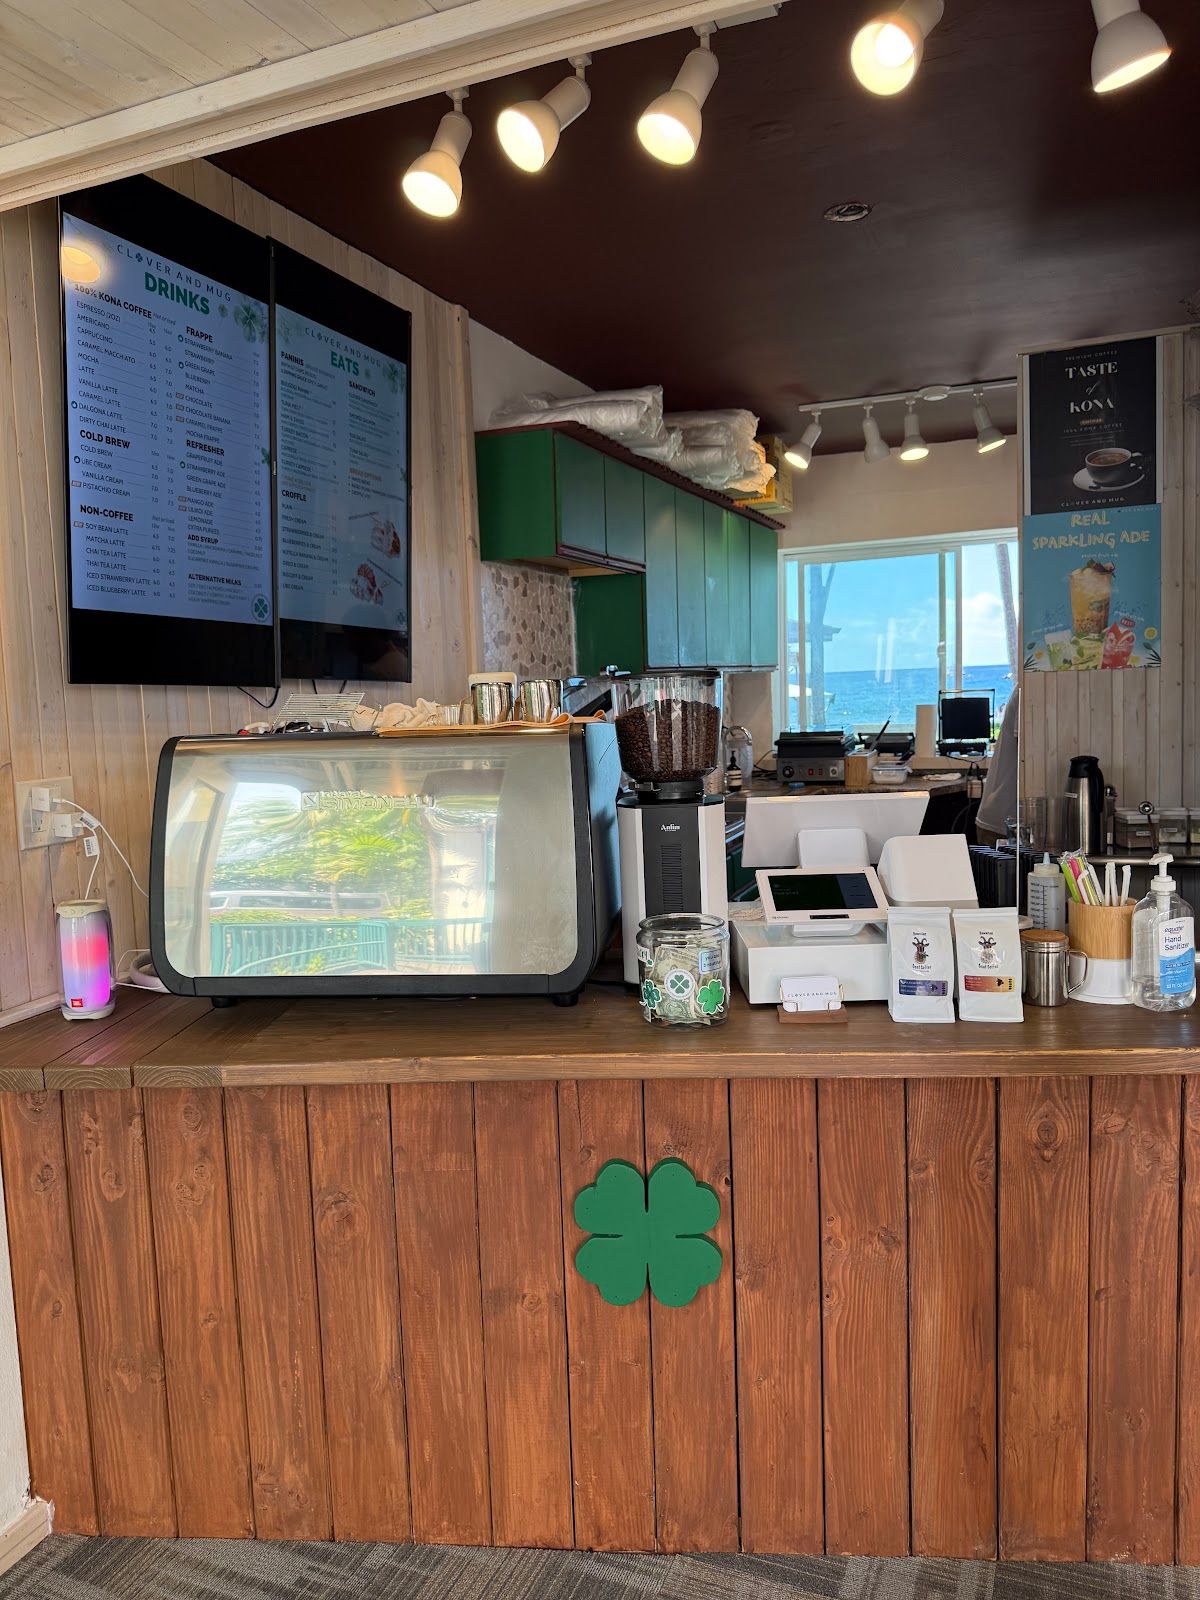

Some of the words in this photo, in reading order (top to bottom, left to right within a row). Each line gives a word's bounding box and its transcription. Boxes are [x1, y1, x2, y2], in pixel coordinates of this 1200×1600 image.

[145, 272, 209, 315] DRINKS
[177, 272, 201, 288] AND
[207, 284, 231, 302] MUG
[75, 284, 97, 298] 100%
[99, 292, 121, 307] KONA
[123, 302, 151, 319] COFFEE
[77, 301, 105, 317] ESPRESSO
[77, 314, 109, 329] AMERICANO
[78, 327, 113, 343] CAPPUCCINO
[186, 326, 213, 343] FRAPPE
[78, 340, 103, 353] CARAMEL
[105, 349, 135, 363] MACCHIATO
[184, 337, 214, 352] STRAWBERRY
[215, 348, 233, 360] BANANA
[344, 346, 361, 358] AND
[78, 353, 99, 364] MOCHA
[281, 351, 304, 366] PANINIS
[330, 351, 359, 376] EATS
[79, 365, 95, 374] LATTE
[185, 361, 200, 371] GREEN
[201, 366, 216, 376] GRAPE
[1065, 361, 1118, 379] TASTE
[79, 378, 102, 390] VANILLA
[103, 385, 118, 394] LATTE
[185, 384, 204, 394] MATCHA
[349, 381, 376, 397] SANDWICH
[79, 390, 104, 403] CARAMEL
[105, 398, 121, 407] LATTE
[185, 395, 213, 408] CHOCOLATE
[1070, 398, 1114, 413] KONA
[79, 403, 106, 416] DALGONA
[107, 410, 123, 420] LATTE
[185, 407, 212, 419] CHOCOLATE
[213, 415, 231, 425] BANANA
[79, 415, 95, 425] DIRTY
[97, 421, 110, 429] CHAI
[110, 424, 127, 433] LATTE
[185, 418, 206, 428] CARAMEL
[80, 429, 103, 442] COLD
[105, 436, 130, 449] BREW
[186, 430, 203, 438] MOCHA
[80, 444, 96, 454] COLD
[97, 448, 113, 457] BREW
[187, 440, 224, 456] REFRESHER
[93, 461, 112, 470] CREAM
[187, 464, 216, 475] STRAWBERRY
[82, 471, 104, 480] VANILLA
[105, 476, 123, 485] CREAM
[186, 474, 202, 483] GREEN
[83, 482, 111, 493] PISTACHIO
[186, 485, 212, 495] BLUEBERRY
[282, 489, 307, 501] CROFFLE
[187, 497, 204, 506] MANGO
[80, 504, 133, 521] NON-COFFEE
[1071, 510, 1110, 527] REAL
[188, 516, 213, 525] LEMONADE
[86, 536, 109, 544] MATCHA
[110, 539, 125, 547] LATTE
[1032, 532, 1116, 550] SPARKLING
[1120, 530, 1150, 543] ADE
[100, 573, 135, 583] STRAWBERRY
[188, 574, 225, 584] ALTERNATIVE
[101, 586, 130, 595] BLUEBERRY
[1164, 935, 1182, 944] Hand
[1164, 942, 1189, 951] Sanitizer
